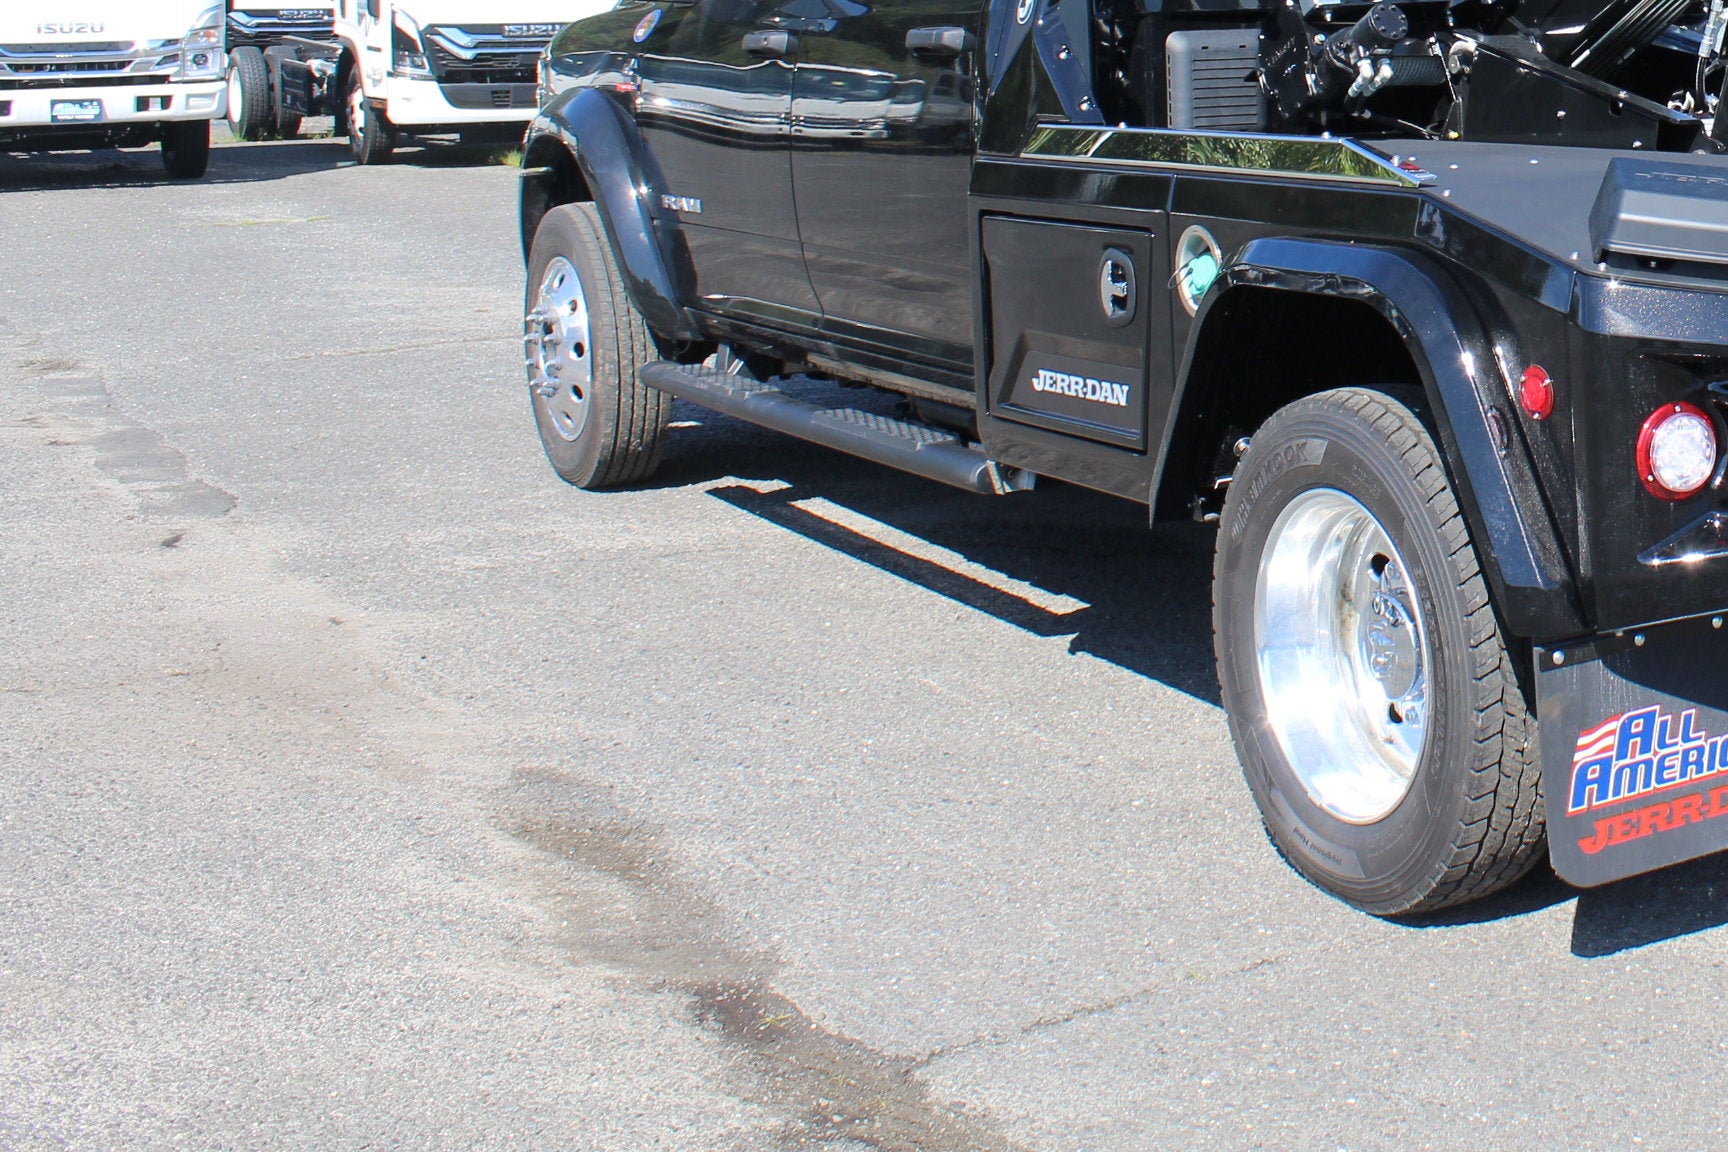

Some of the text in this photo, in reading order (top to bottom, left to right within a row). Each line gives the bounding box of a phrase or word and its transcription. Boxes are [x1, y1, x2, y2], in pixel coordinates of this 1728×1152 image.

[37, 22, 105, 35] ISUZU
[503, 24, 562, 37] ISUZU
[660, 193, 703, 215] RAM
[1031, 368, 1130, 407] JERR-DAN
[1613, 704, 1706, 763] ALL
